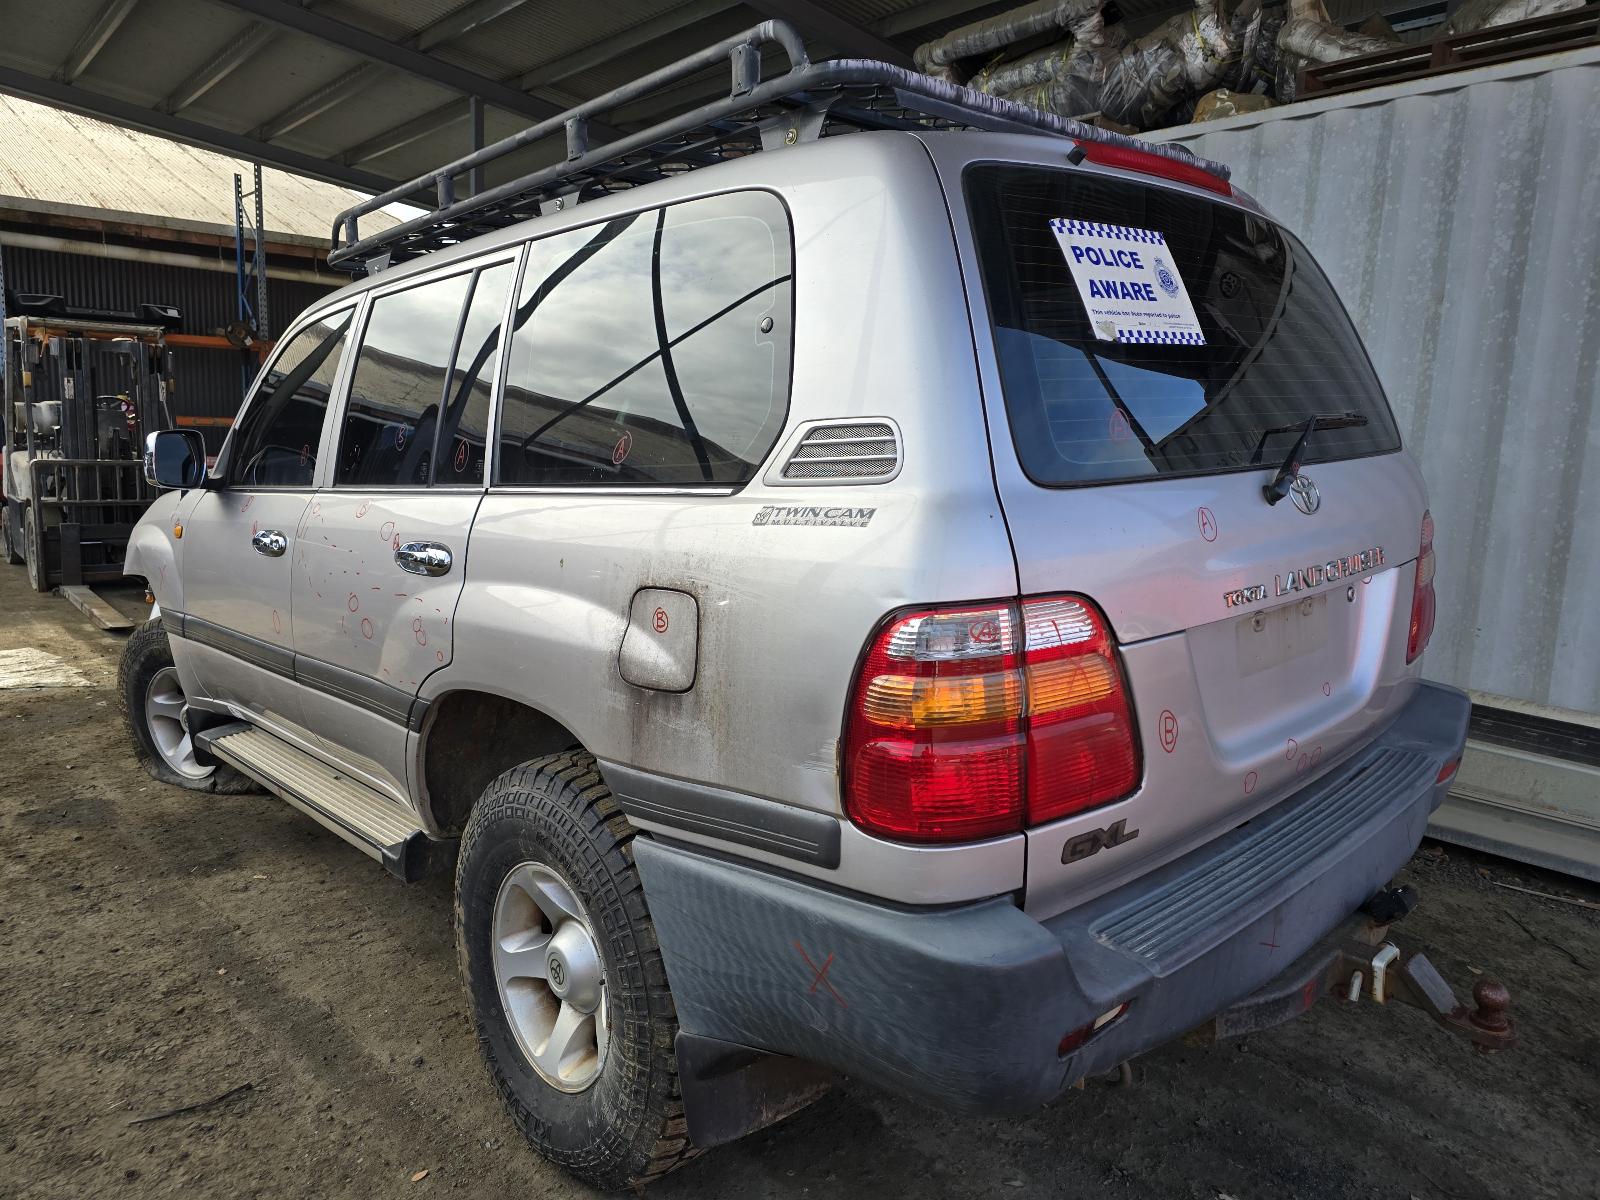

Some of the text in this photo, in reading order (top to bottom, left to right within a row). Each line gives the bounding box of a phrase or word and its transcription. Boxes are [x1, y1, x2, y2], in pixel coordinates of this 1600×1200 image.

[1071, 245, 1144, 269] POLICE
[1089, 279, 1157, 301] AWARE
[770, 519, 869, 528] MULTIVALVE
[773, 507, 877, 519] TWIN CAM
[1223, 546, 1385, 608] TOYOTA LAND CRUISER
[1060, 817, 1140, 866] GXL
